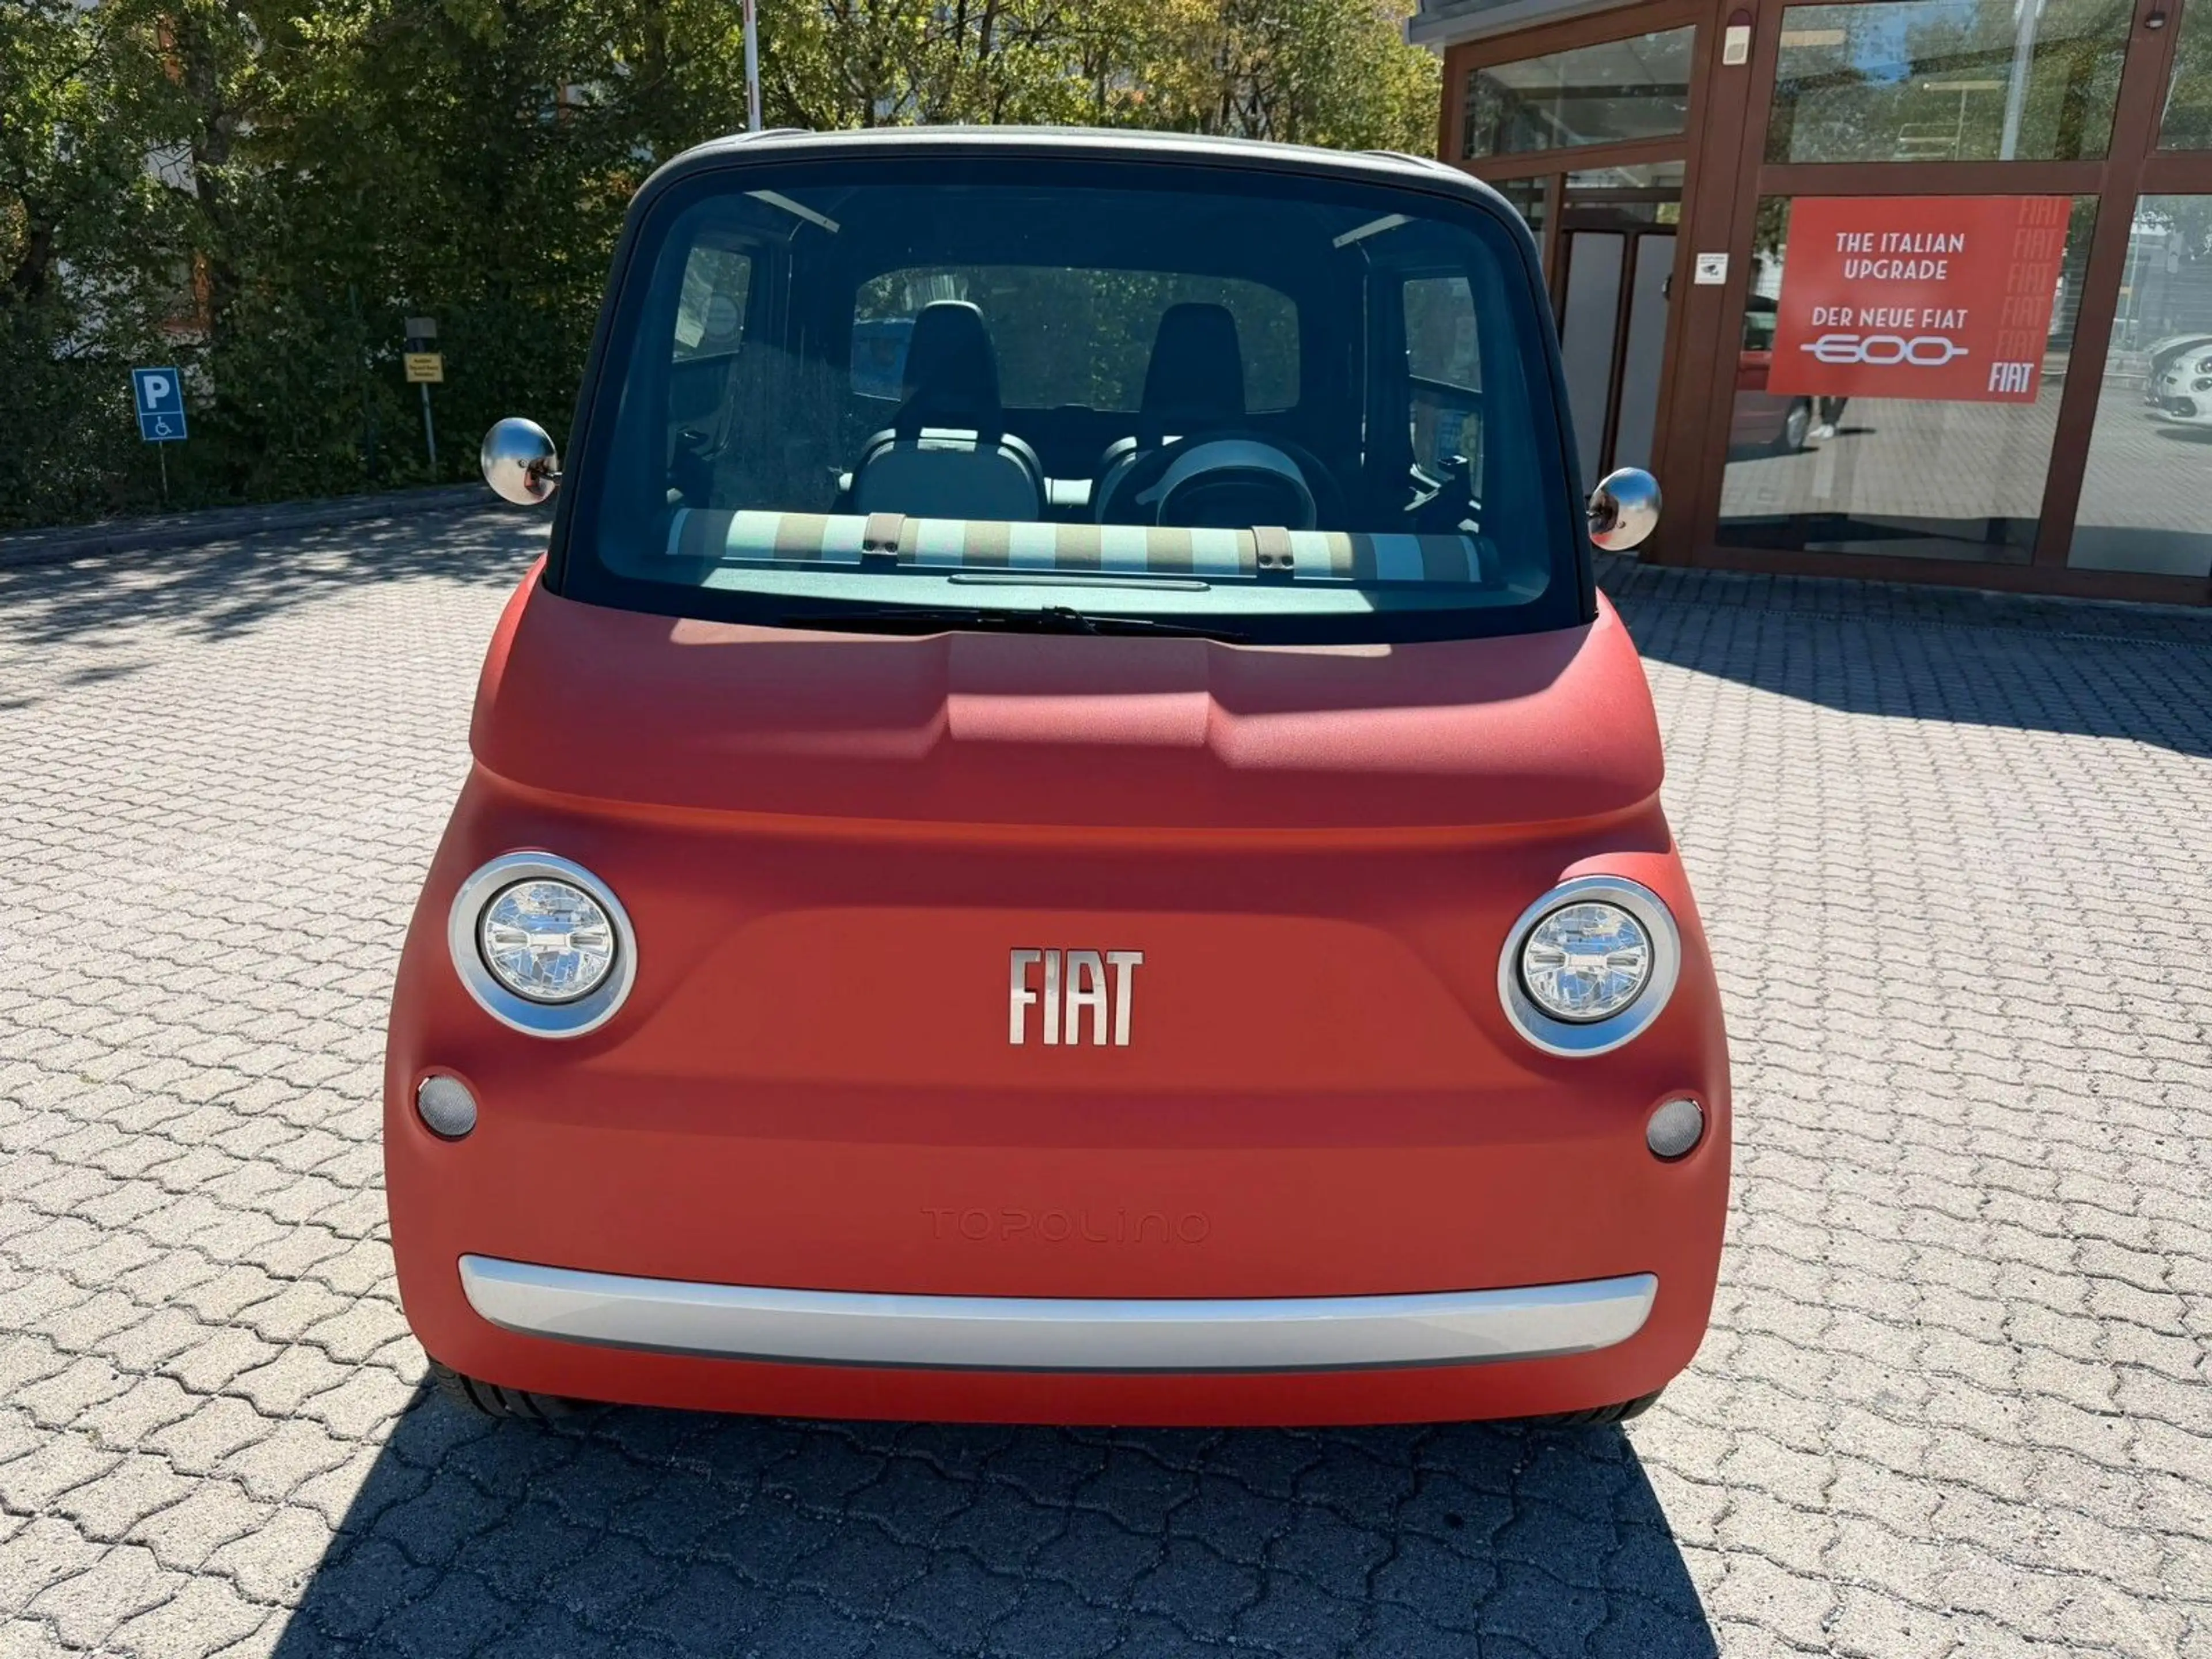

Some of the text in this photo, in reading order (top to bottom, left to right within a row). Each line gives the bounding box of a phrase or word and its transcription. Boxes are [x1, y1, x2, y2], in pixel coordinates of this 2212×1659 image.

[2018, 197, 2062, 225] FIAT
[1836, 232, 1965, 253] THE ITALIAN
[2013, 228, 2059, 259] FIAT
[1844, 259, 1948, 280] UPGRADE
[2007, 263, 2052, 294] FIAT
[1812, 306, 1968, 329] DER NEUE FIAT
[2001, 296, 2046, 326] FIAT
[1800, 334, 1969, 366] 600
[1995, 329, 2040, 359] FIAT
[143, 376, 169, 408] P
[1988, 362, 2035, 393] FIAT
[1009, 948, 1144, 1046] FIAT
